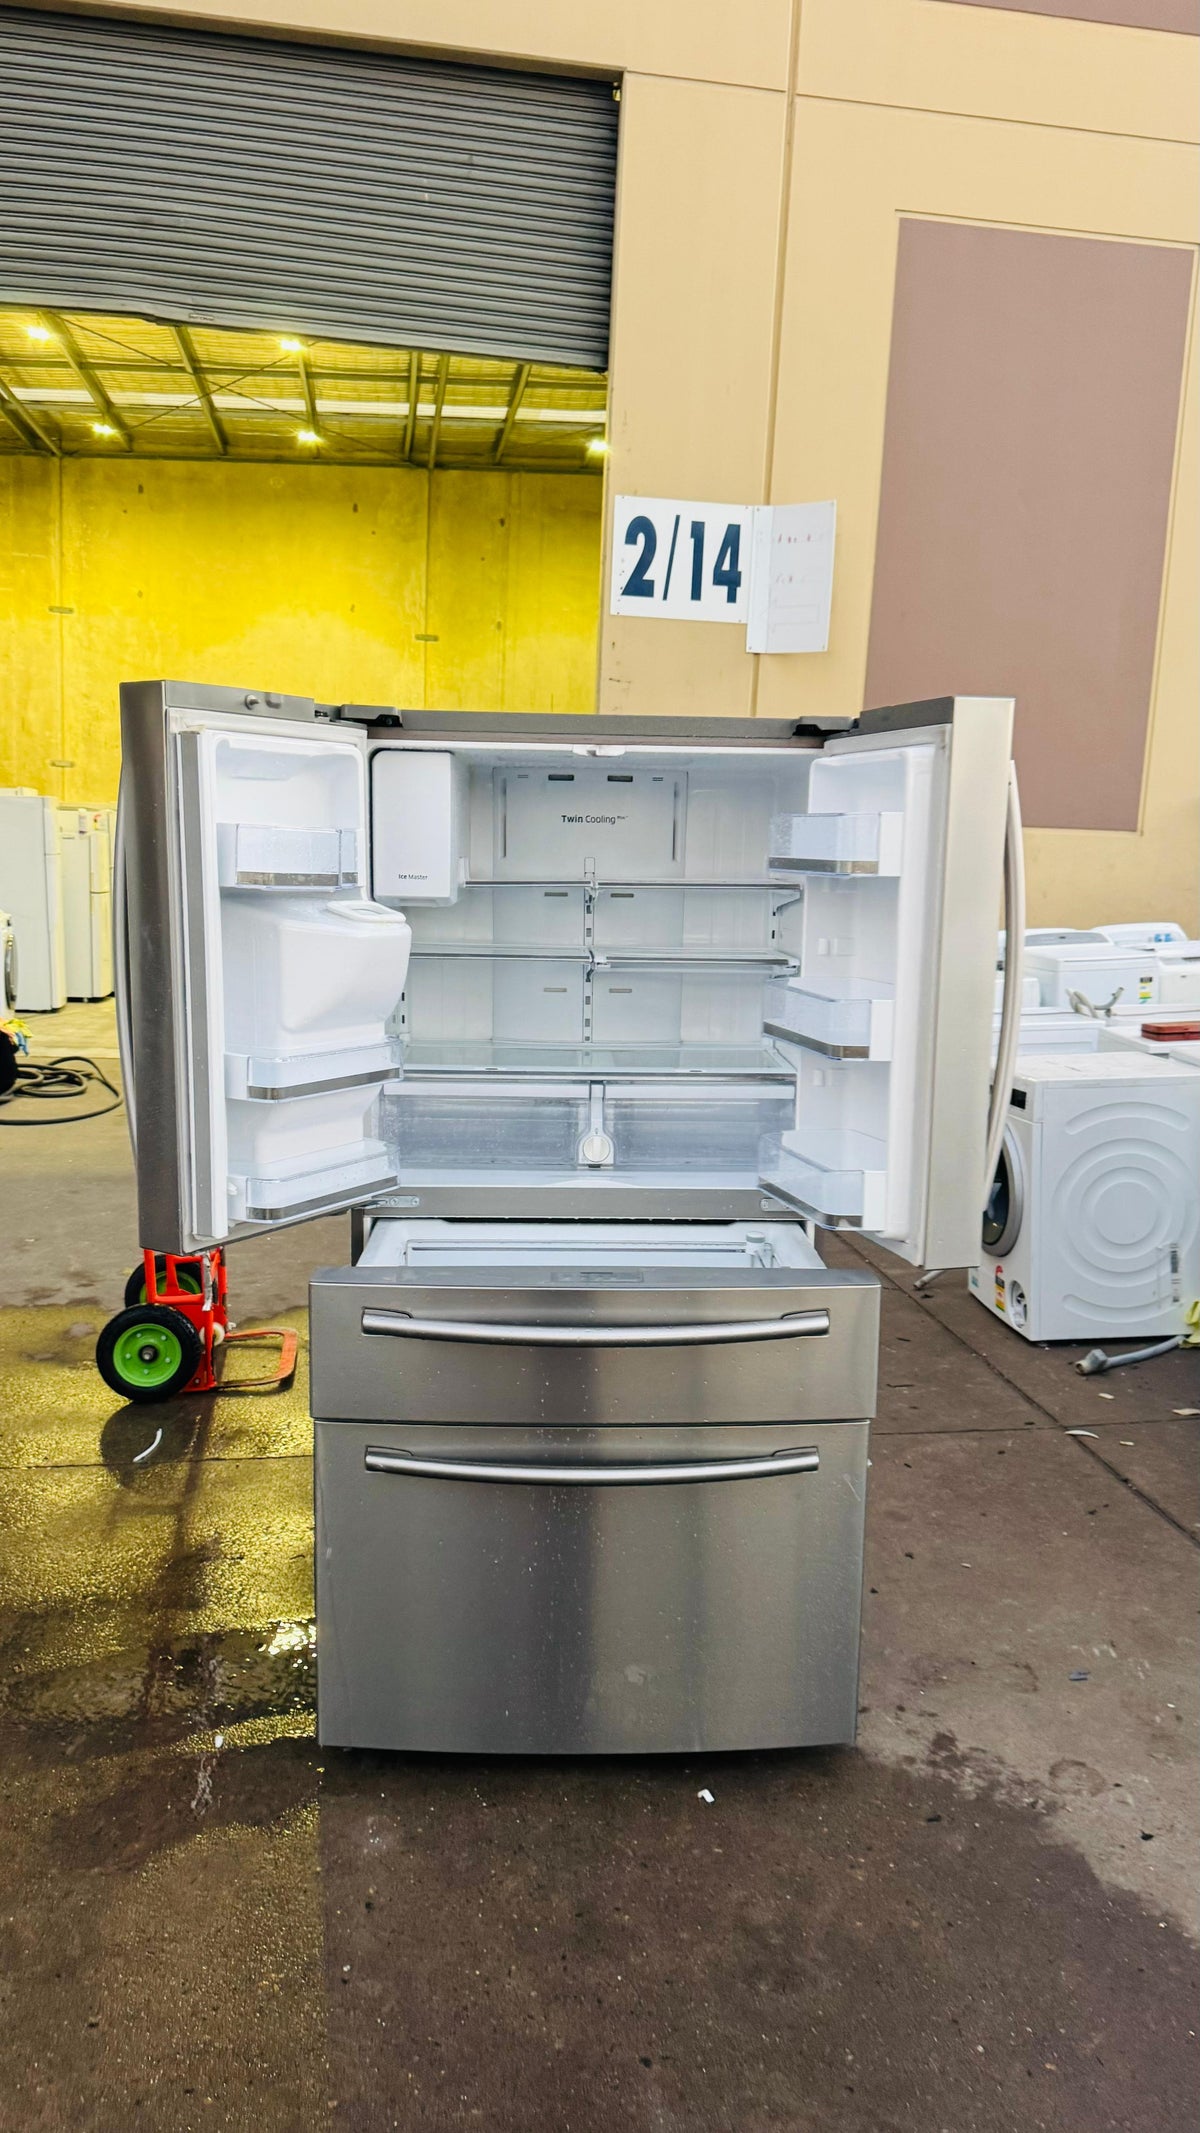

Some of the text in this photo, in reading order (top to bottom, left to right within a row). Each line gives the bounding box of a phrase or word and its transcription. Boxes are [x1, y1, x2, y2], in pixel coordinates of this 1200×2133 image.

[621, 515, 742, 603] 2/14
[561, 814, 583, 823] Twin
[585, 815, 616, 825] Cooling
